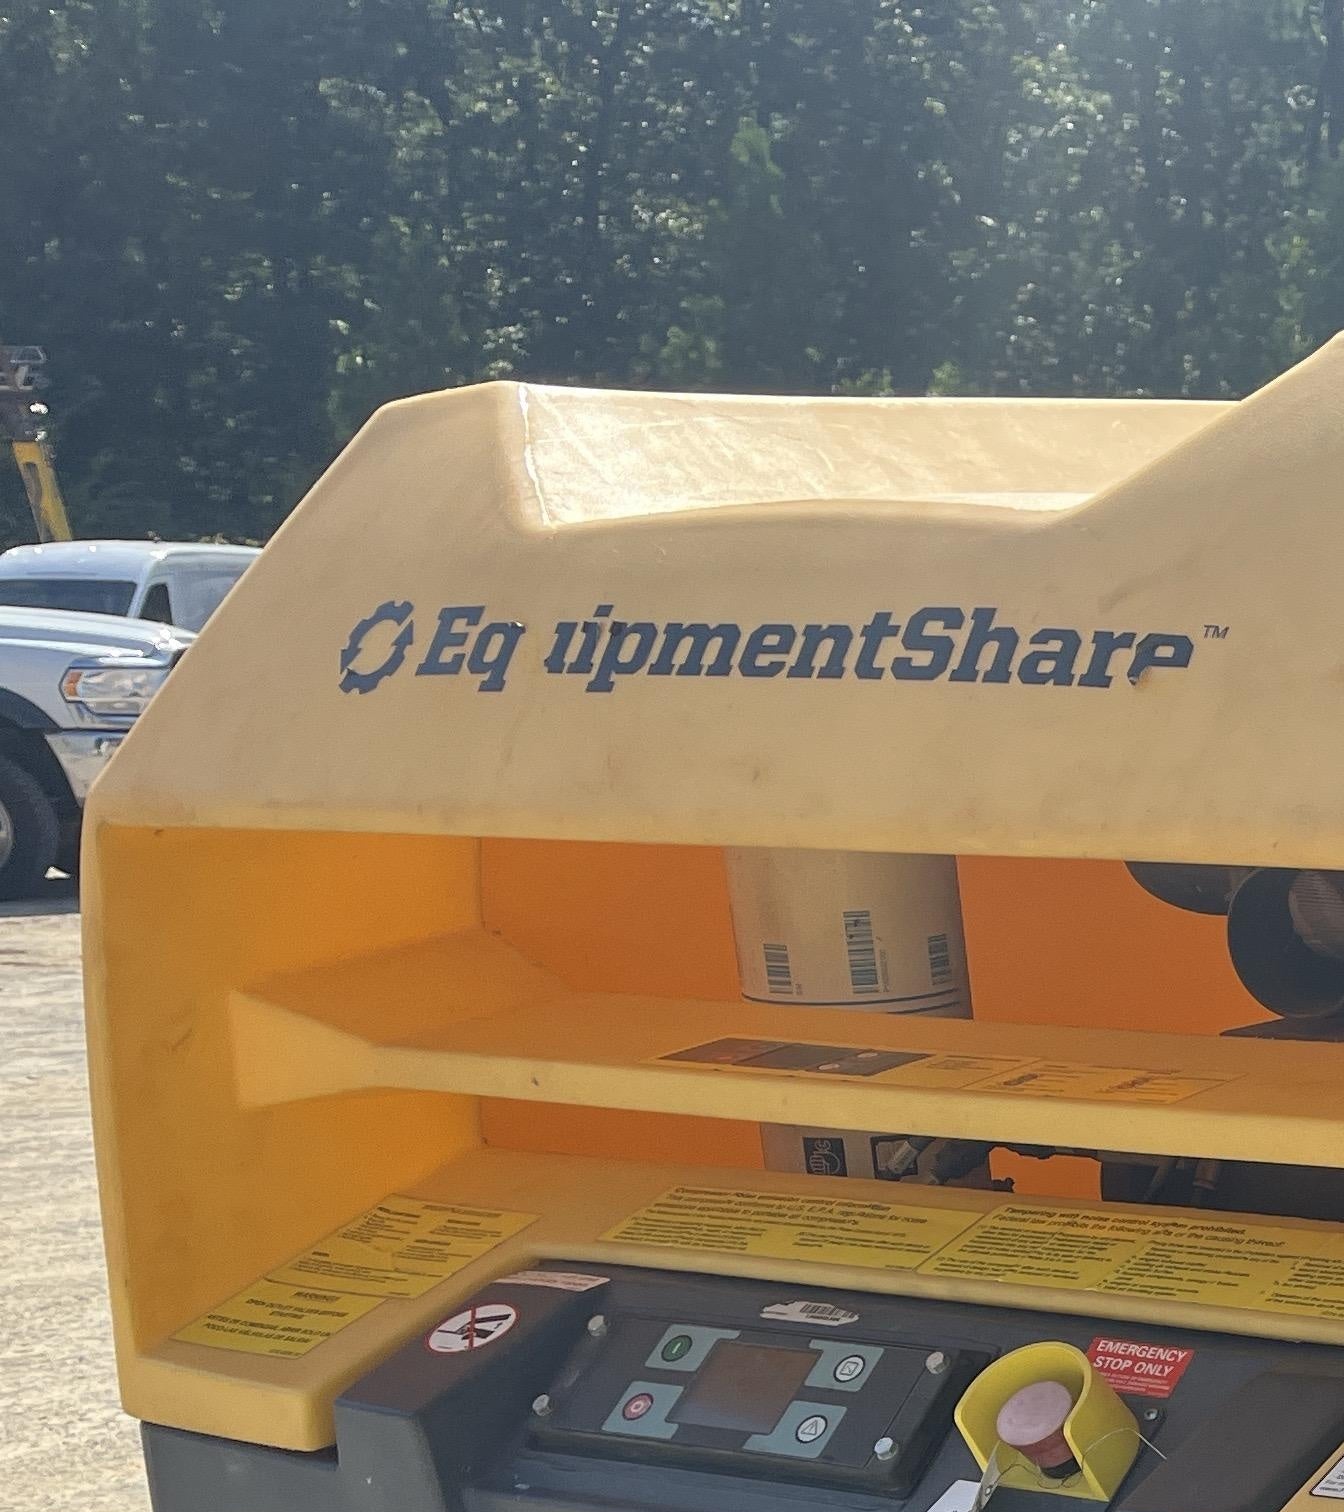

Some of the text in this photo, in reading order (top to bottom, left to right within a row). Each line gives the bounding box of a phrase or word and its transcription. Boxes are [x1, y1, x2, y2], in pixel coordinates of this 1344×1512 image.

[1096, 1340, 1188, 1363] EMERGENCY
[1093, 1355, 1175, 1377] STOP ONLY
